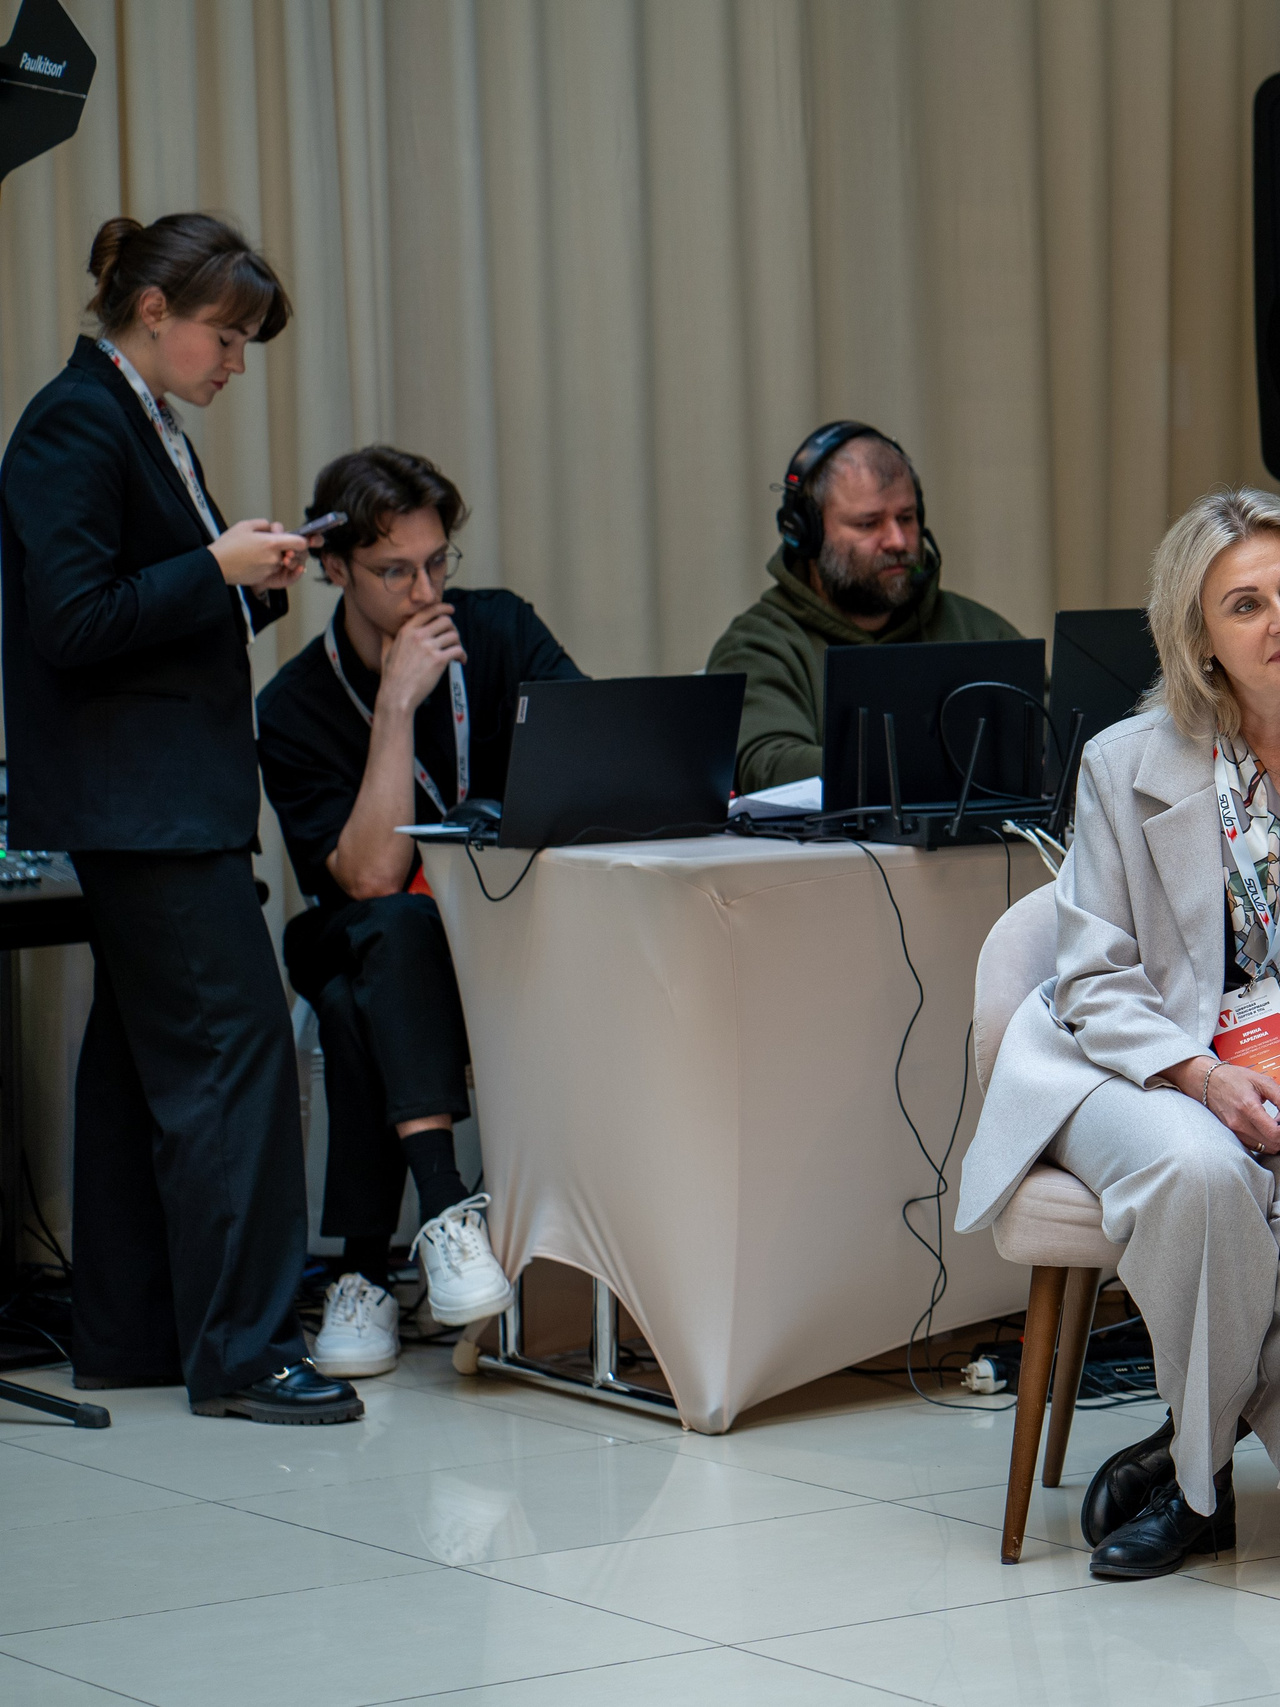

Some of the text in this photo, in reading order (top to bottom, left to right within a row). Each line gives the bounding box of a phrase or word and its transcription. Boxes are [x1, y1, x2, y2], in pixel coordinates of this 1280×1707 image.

[20, 52, 64, 78] Paulkitson
[1239, 1031, 1269, 1045] КАРЕЛИНА
[1242, 1027, 1262, 1037] ИРИНА
